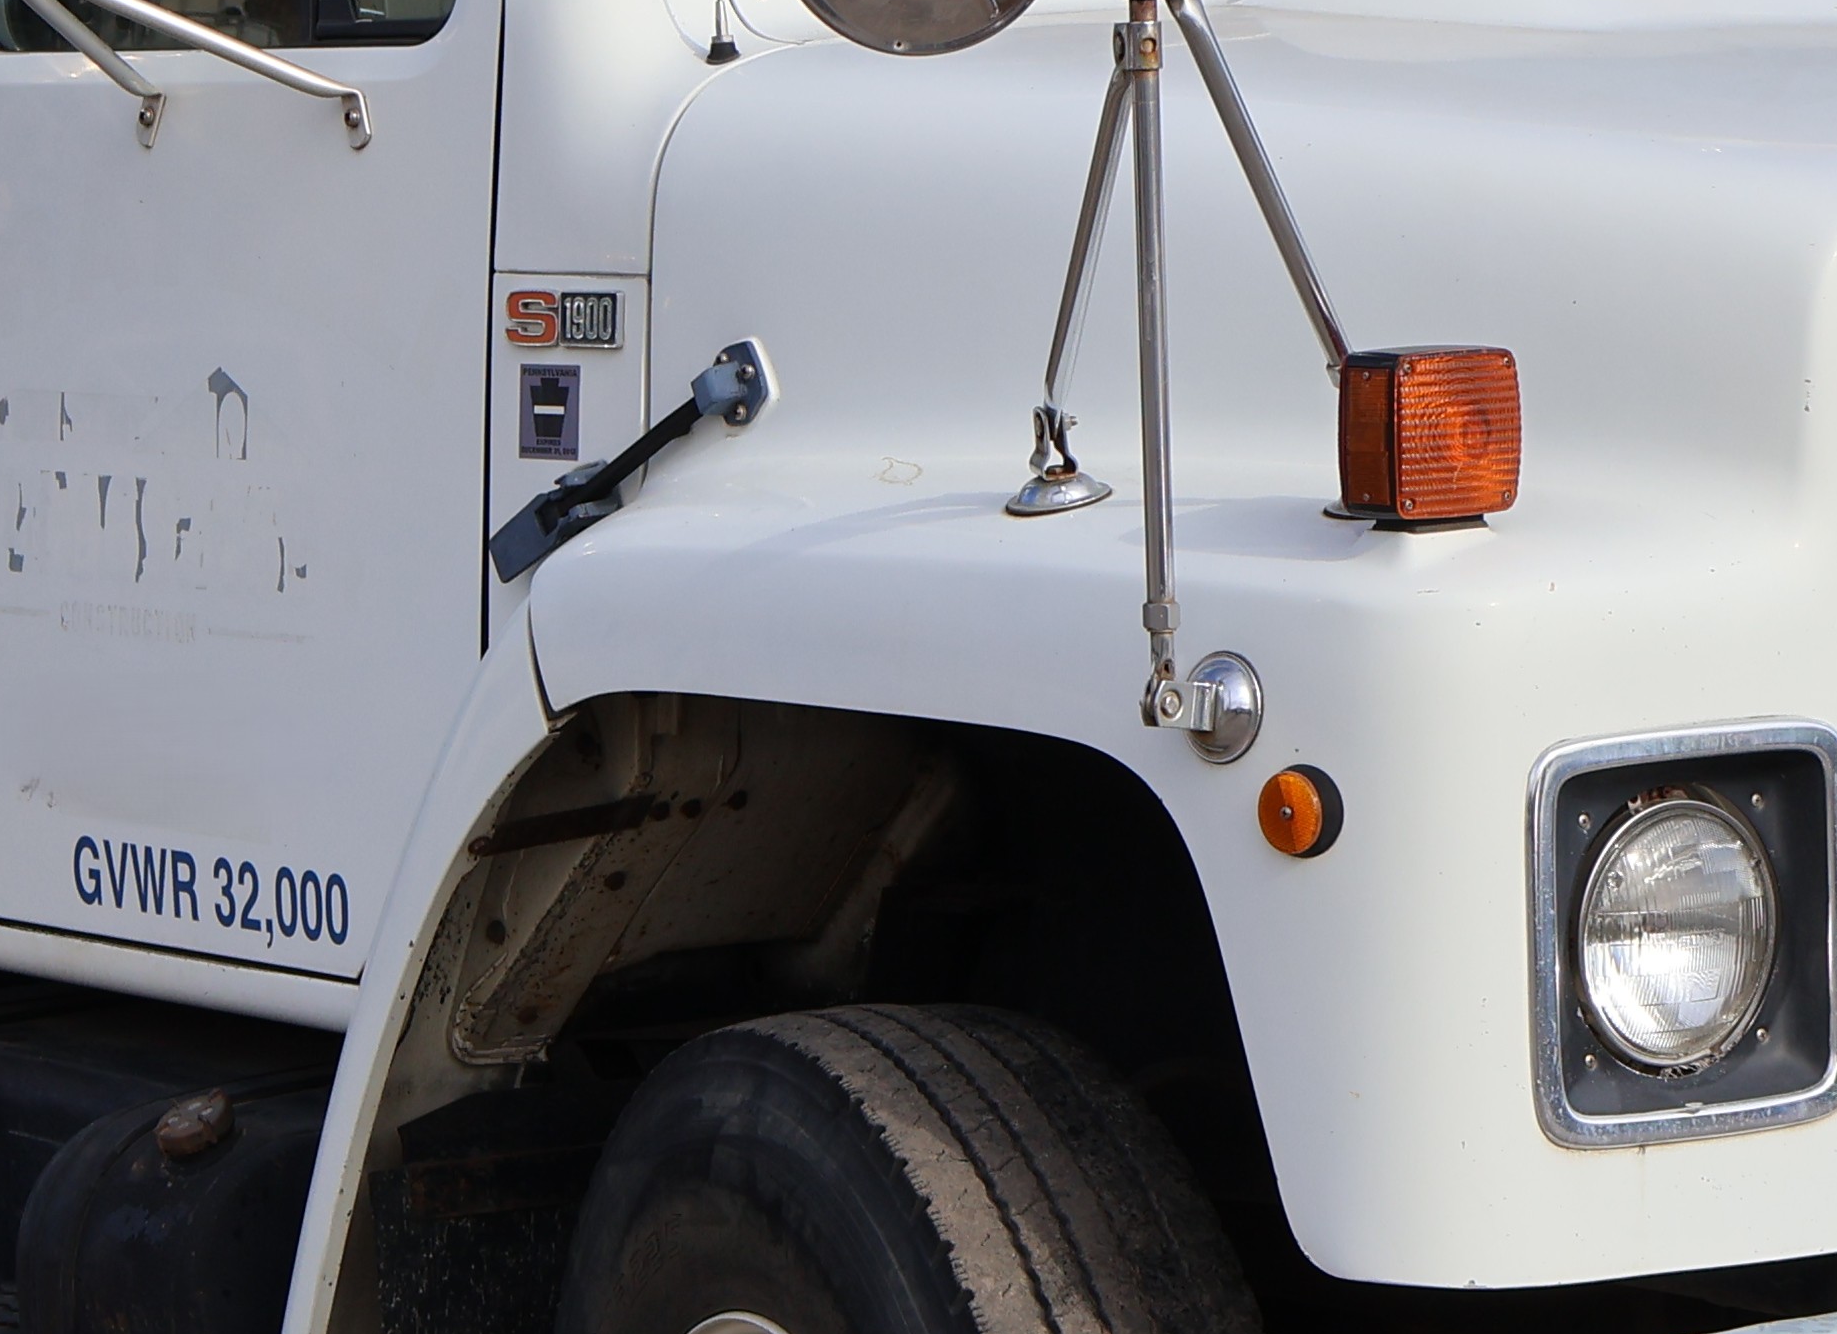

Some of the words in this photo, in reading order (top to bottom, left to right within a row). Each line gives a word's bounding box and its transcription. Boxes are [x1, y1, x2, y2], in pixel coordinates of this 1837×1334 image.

[563, 296, 614, 340] 1900
[73, 834, 200, 922] GVWR
[212, 856, 350, 949] 32,000
